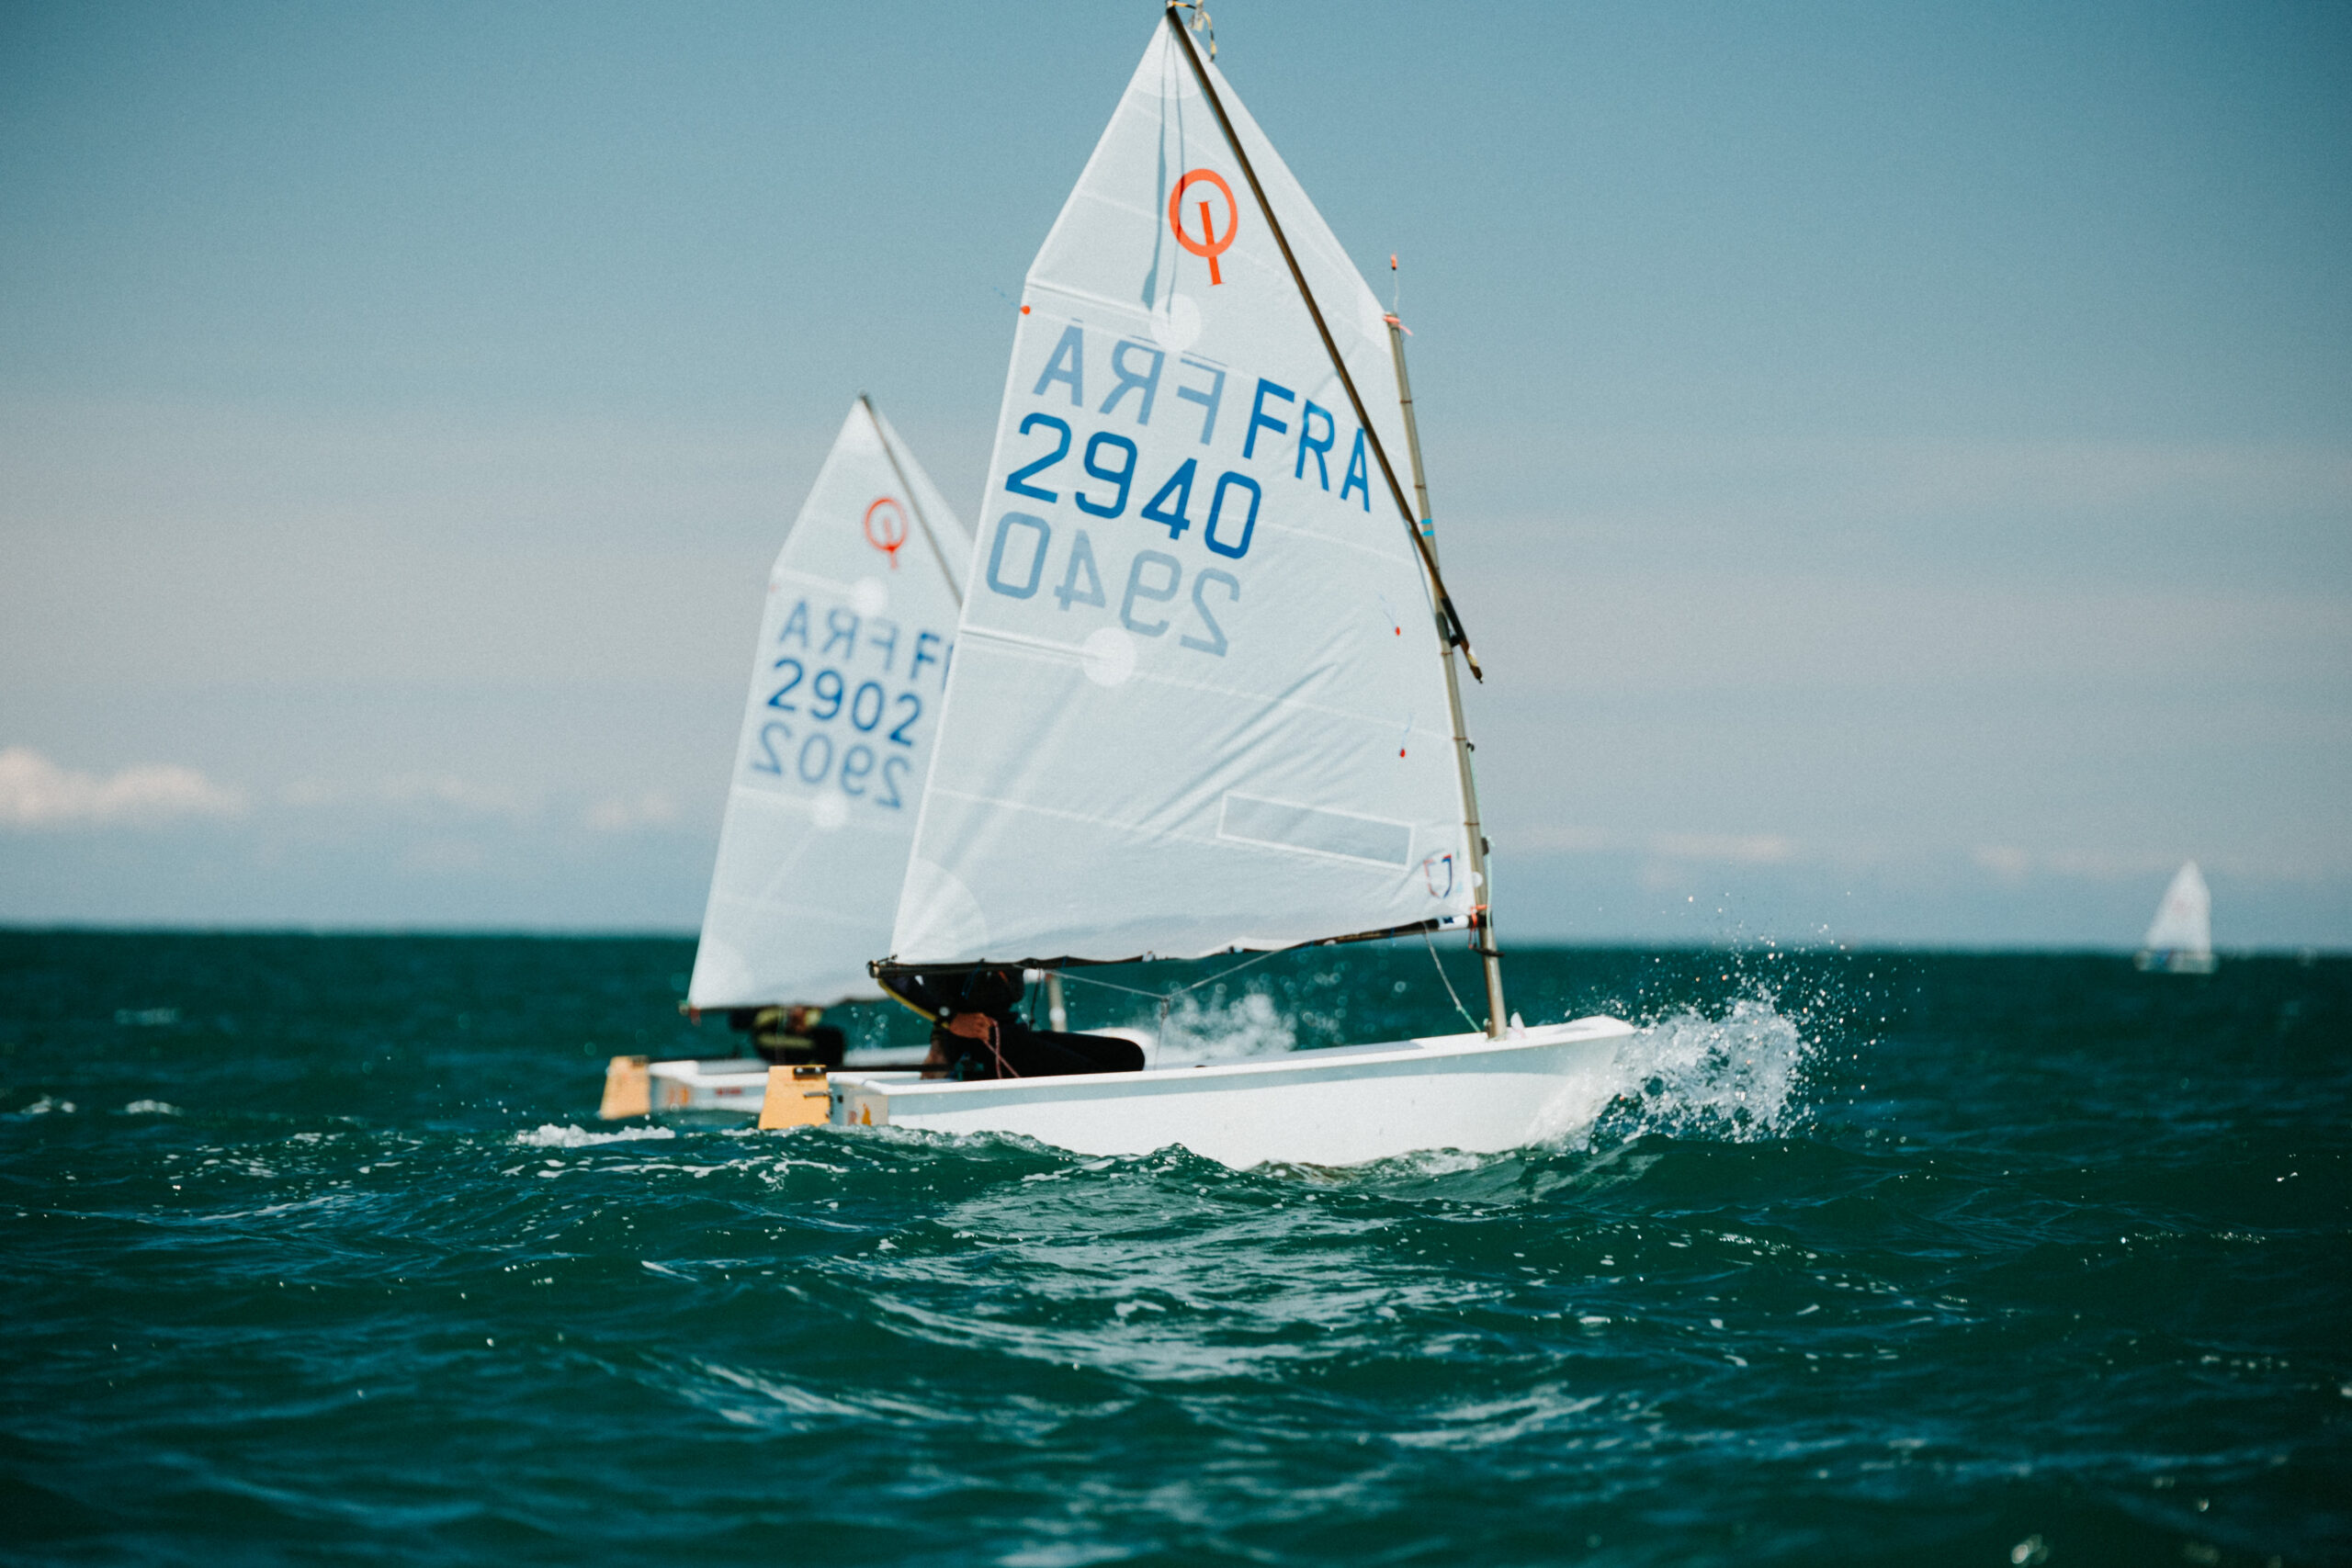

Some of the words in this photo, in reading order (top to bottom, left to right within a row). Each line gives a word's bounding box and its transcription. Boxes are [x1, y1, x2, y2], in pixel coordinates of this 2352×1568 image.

[1004, 412, 1262, 559] 2940
[1242, 377, 1371, 513] FRA
[767, 658, 922, 748] 2902
